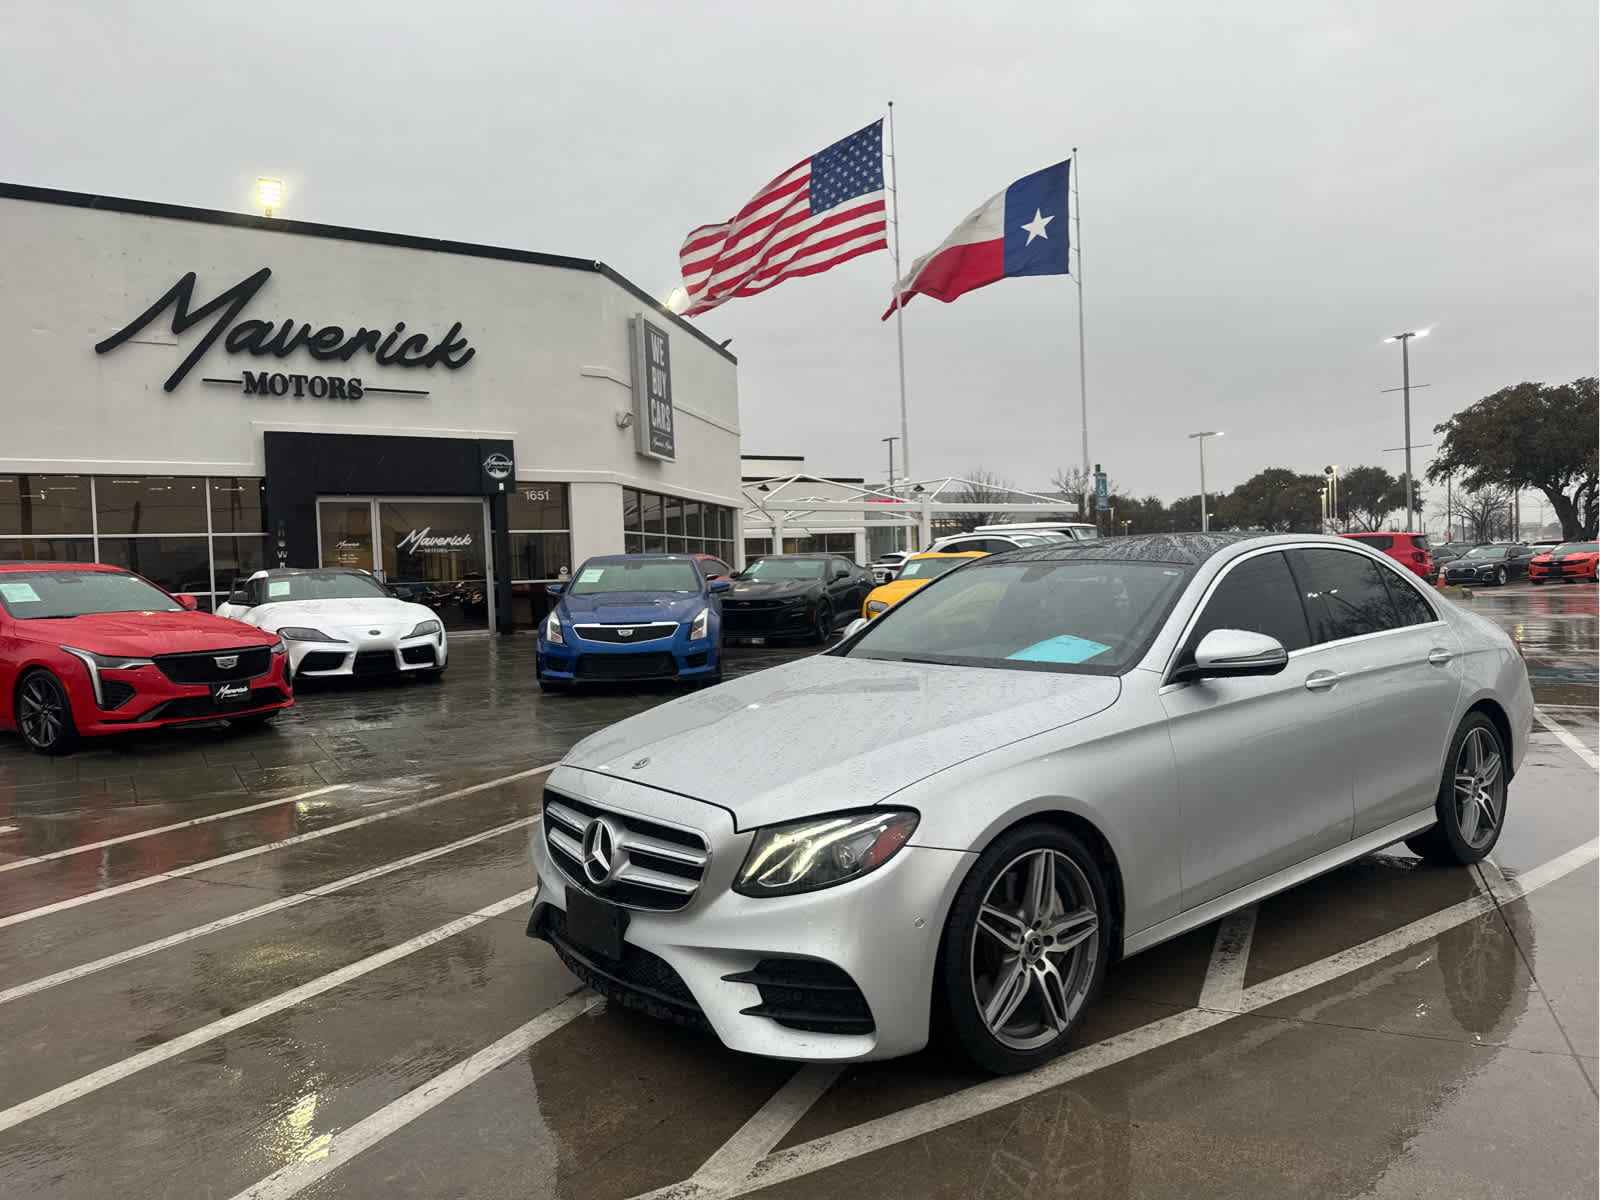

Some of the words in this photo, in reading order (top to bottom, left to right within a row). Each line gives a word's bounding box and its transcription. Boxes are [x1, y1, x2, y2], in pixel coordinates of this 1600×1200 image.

[95, 267, 476, 392] Maverick
[650, 332, 665, 367] WE
[242, 370, 364, 400] MOTORS
[651, 366, 667, 400] BUY
[650, 398, 671, 433] CARS
[525, 490, 550, 501] 1651
[397, 526, 473, 555] Maverick
